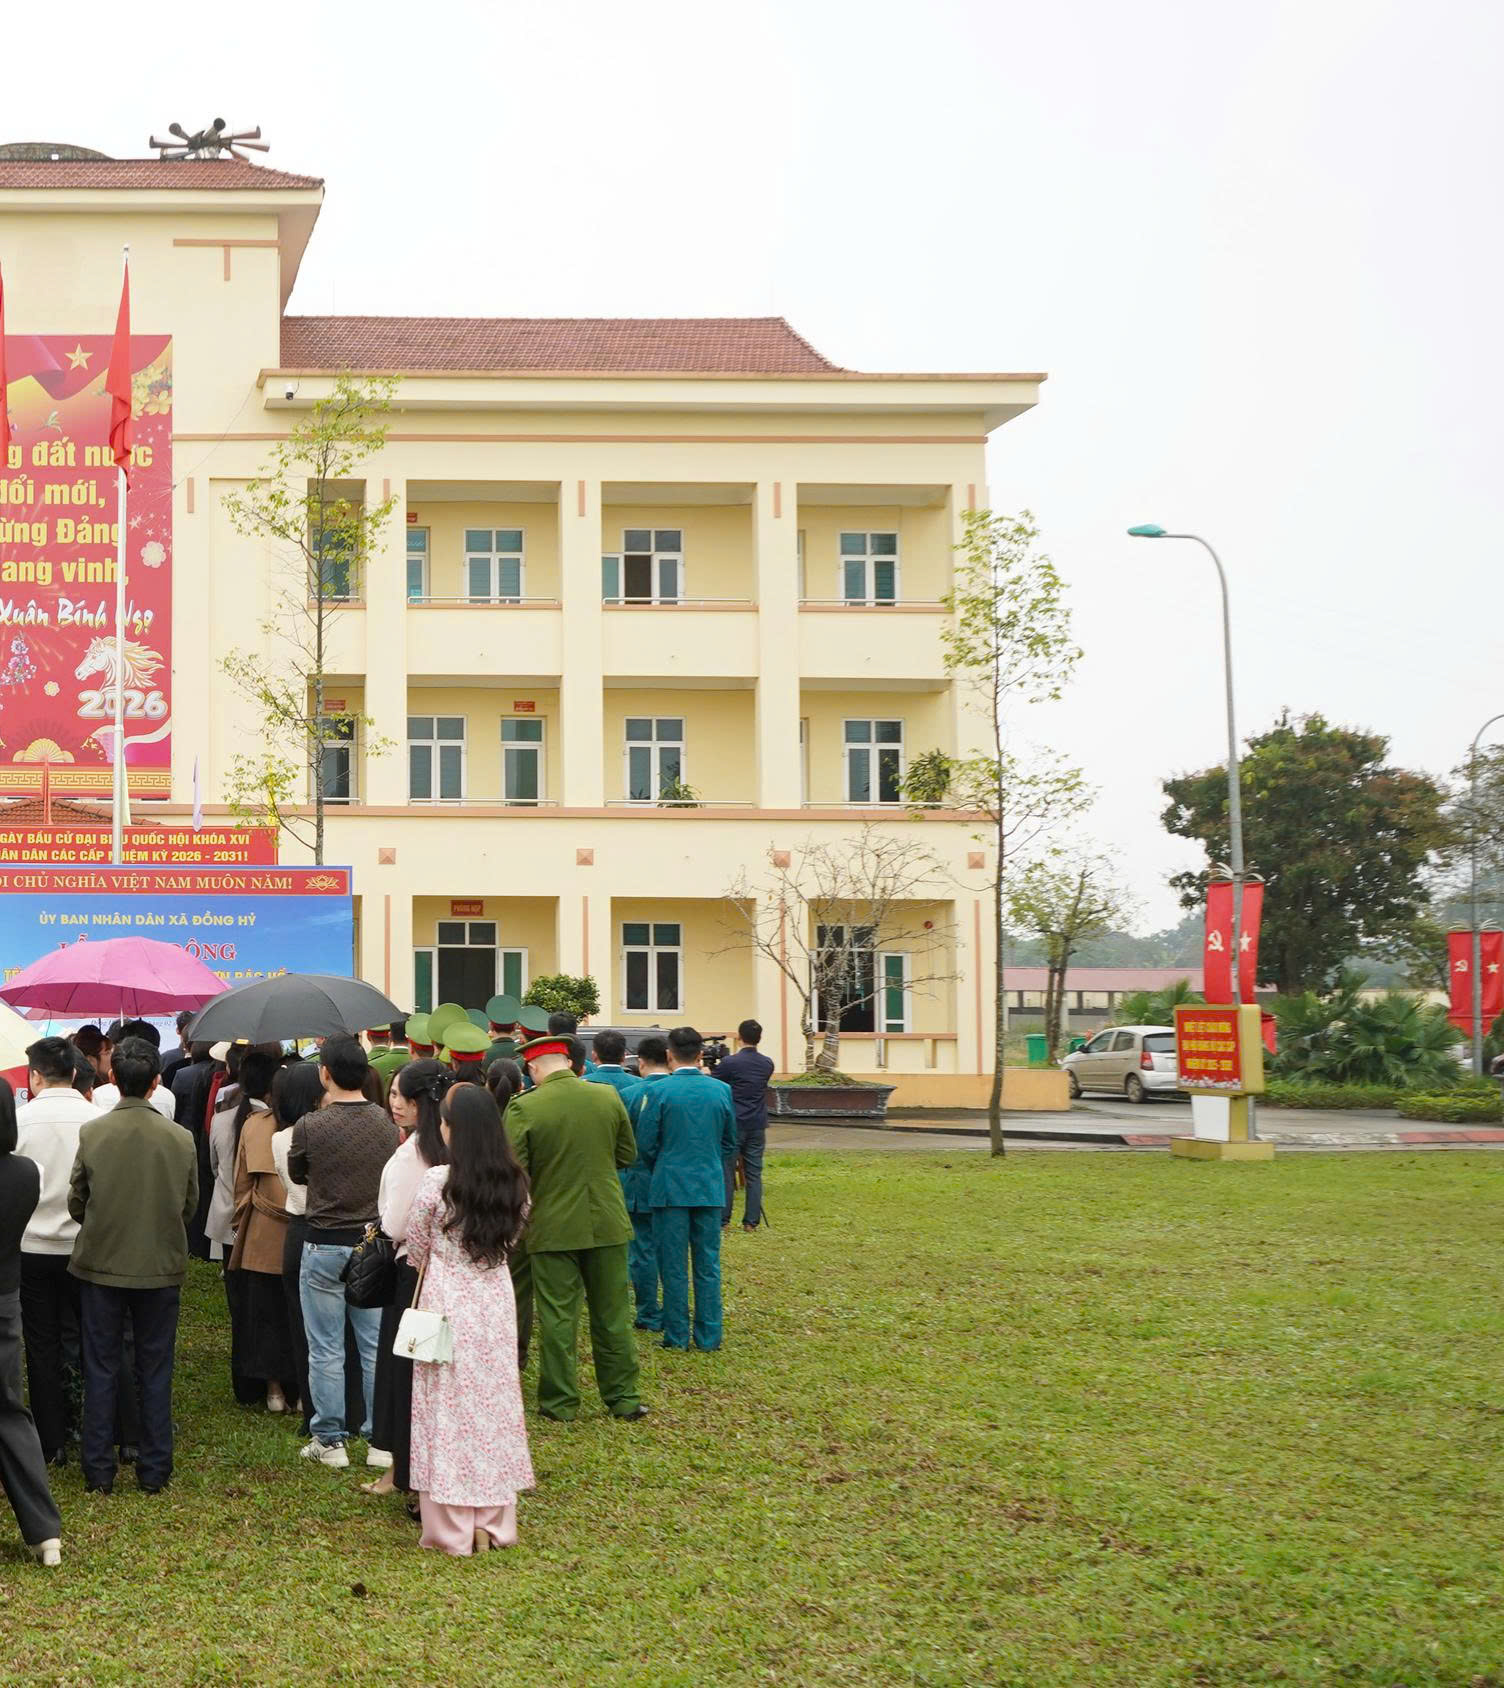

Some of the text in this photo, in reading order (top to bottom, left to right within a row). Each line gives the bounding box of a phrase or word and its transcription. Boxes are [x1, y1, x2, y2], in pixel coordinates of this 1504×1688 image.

[32, 437, 75, 467] đất
[44, 479, 105, 508] mới,
[58, 597, 107, 627] Bính
[77, 690, 168, 719] 2026
[0, 832, 24, 844] GÀY
[27, 830, 52, 844] BẦU
[56, 832, 74, 845] CỬ
[76, 833, 96, 847] ĐẠI
[100, 834, 128, 845] BIU
[132, 831, 165, 845] QUỐC
[169, 832, 189, 847] HỘI
[193, 832, 227, 845] KHÓA
[230, 834, 249, 845] XVI
[22, 848, 48, 861] DÂN
[52, 848, 76, 861] CÁC
[80, 847, 104, 861] CẤP
[152, 849, 168, 862] KỲ
[172, 851, 201, 862] 2026
[214, 851, 248, 862] 2031!
[13, 870, 49, 888] CHỦ
[53, 872, 107, 888] NGHĨA
[111, 872, 150, 892] VIỆT
[155, 876, 192, 889] NAM
[196, 873, 246, 889] MUÔN
[251, 873, 292, 890] NĂM!
[39, 910, 56, 925] ỦY
[60, 914, 88, 925] BAN
[93, 912, 132, 925] NHÂN
[135, 912, 165, 925] DÂN
[168, 912, 188, 925] XÃ
[192, 910, 234, 926] ĐỒNG
